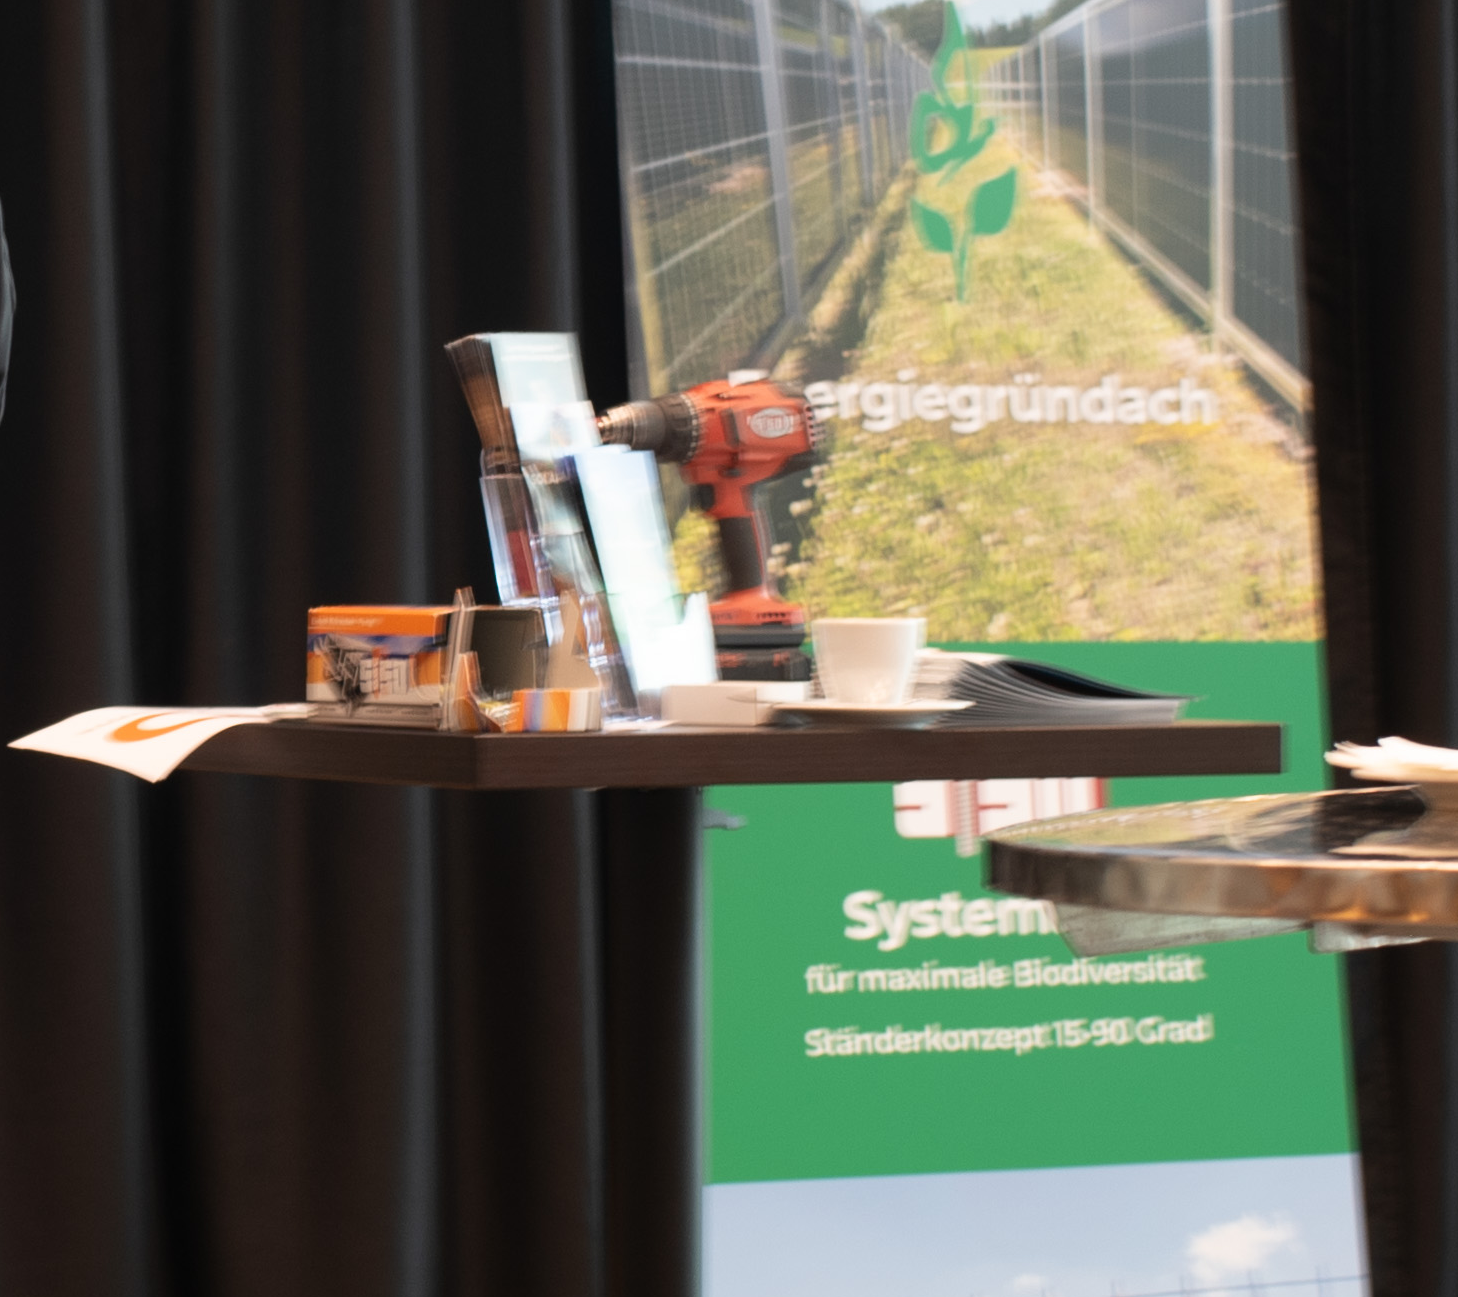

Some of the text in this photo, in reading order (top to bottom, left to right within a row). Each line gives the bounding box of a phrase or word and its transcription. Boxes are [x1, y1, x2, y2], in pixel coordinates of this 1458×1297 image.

[805, 953, 1206, 994] für maximale Biodiversität
[804, 1013, 1214, 1057] Ständerkonzept 15-90 Grad
